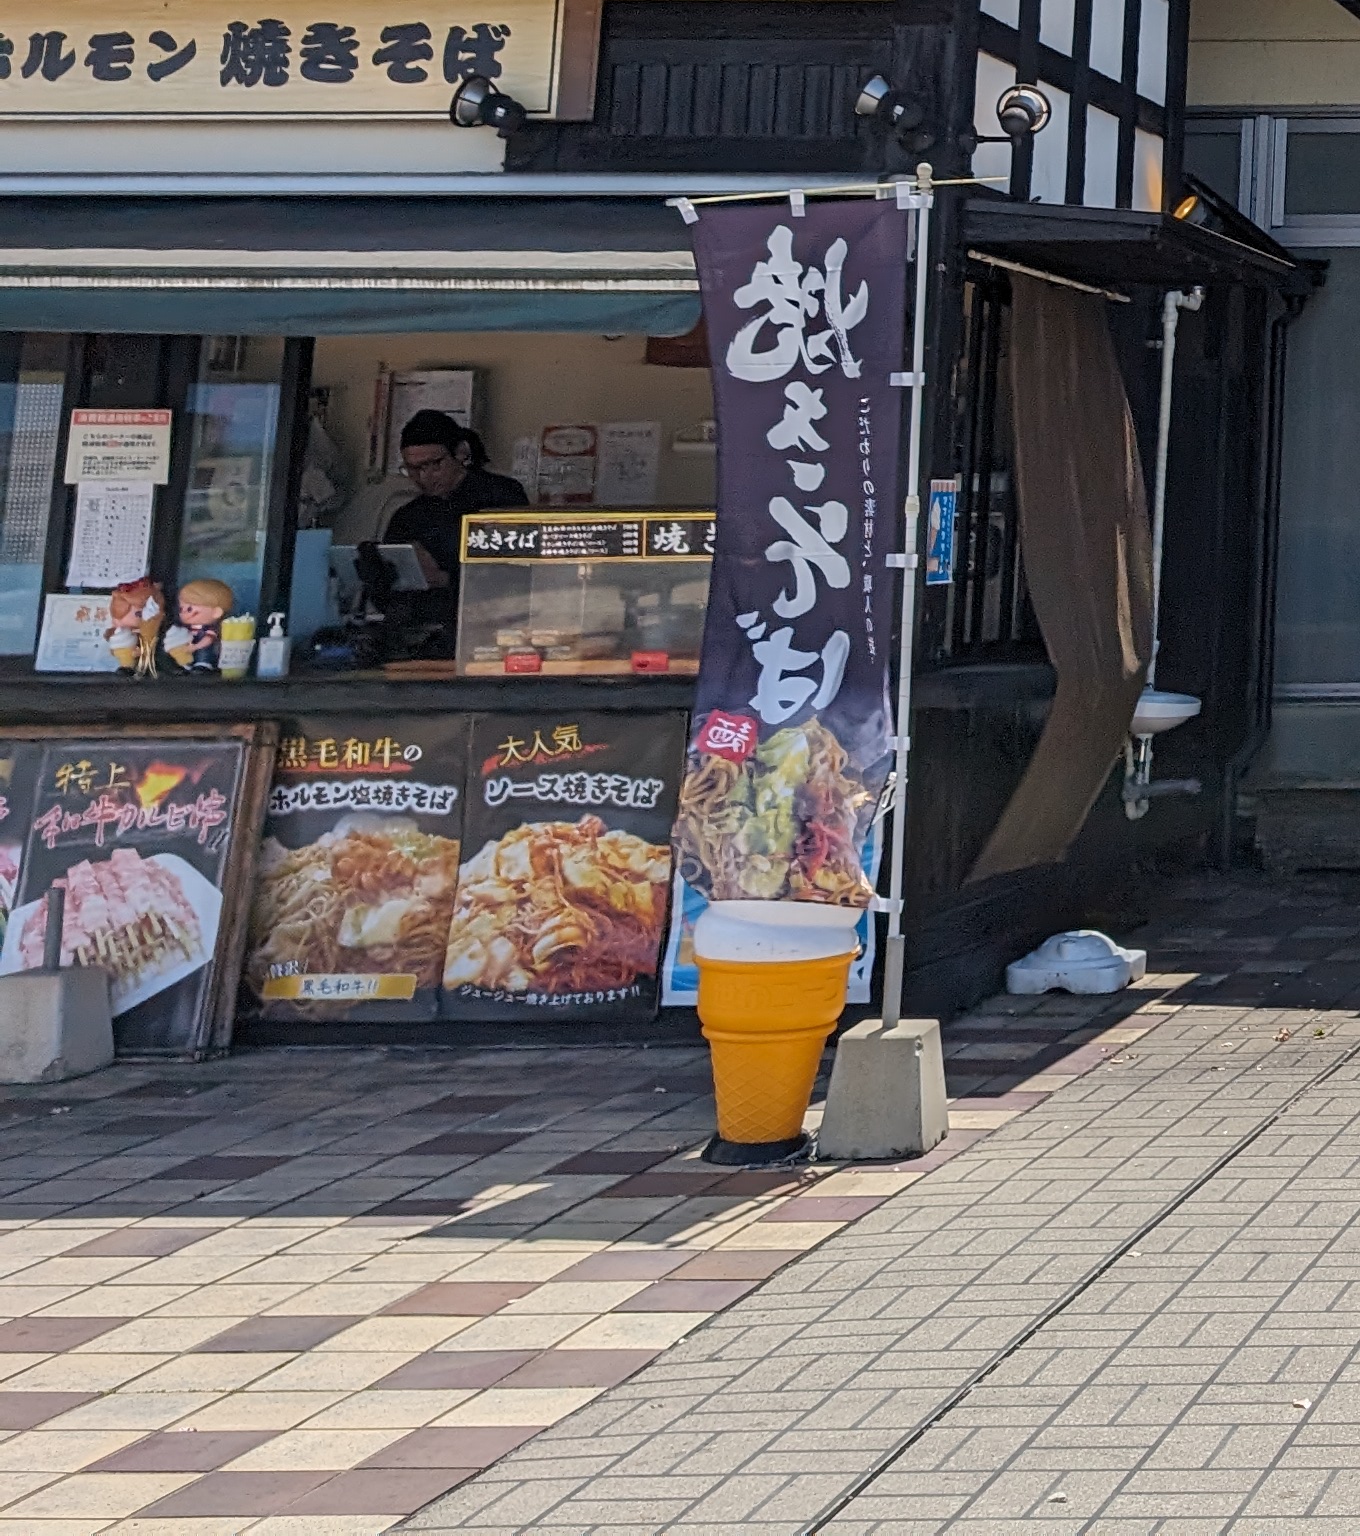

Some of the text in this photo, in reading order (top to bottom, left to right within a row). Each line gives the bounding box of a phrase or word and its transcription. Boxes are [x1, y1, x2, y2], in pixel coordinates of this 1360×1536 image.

[0, 19, 511, 88] ルモン 焼きそば
[467, 529, 538, 552] 焼きそば
[281, 736, 422, 768] 黒毛和牛の
[498, 724, 581, 765] 大人気
[55, 759, 131, 794] 特上
[485, 774, 665, 808] ソース焼きそば
[269, 778, 459, 814] ホルモン塩焼きそば
